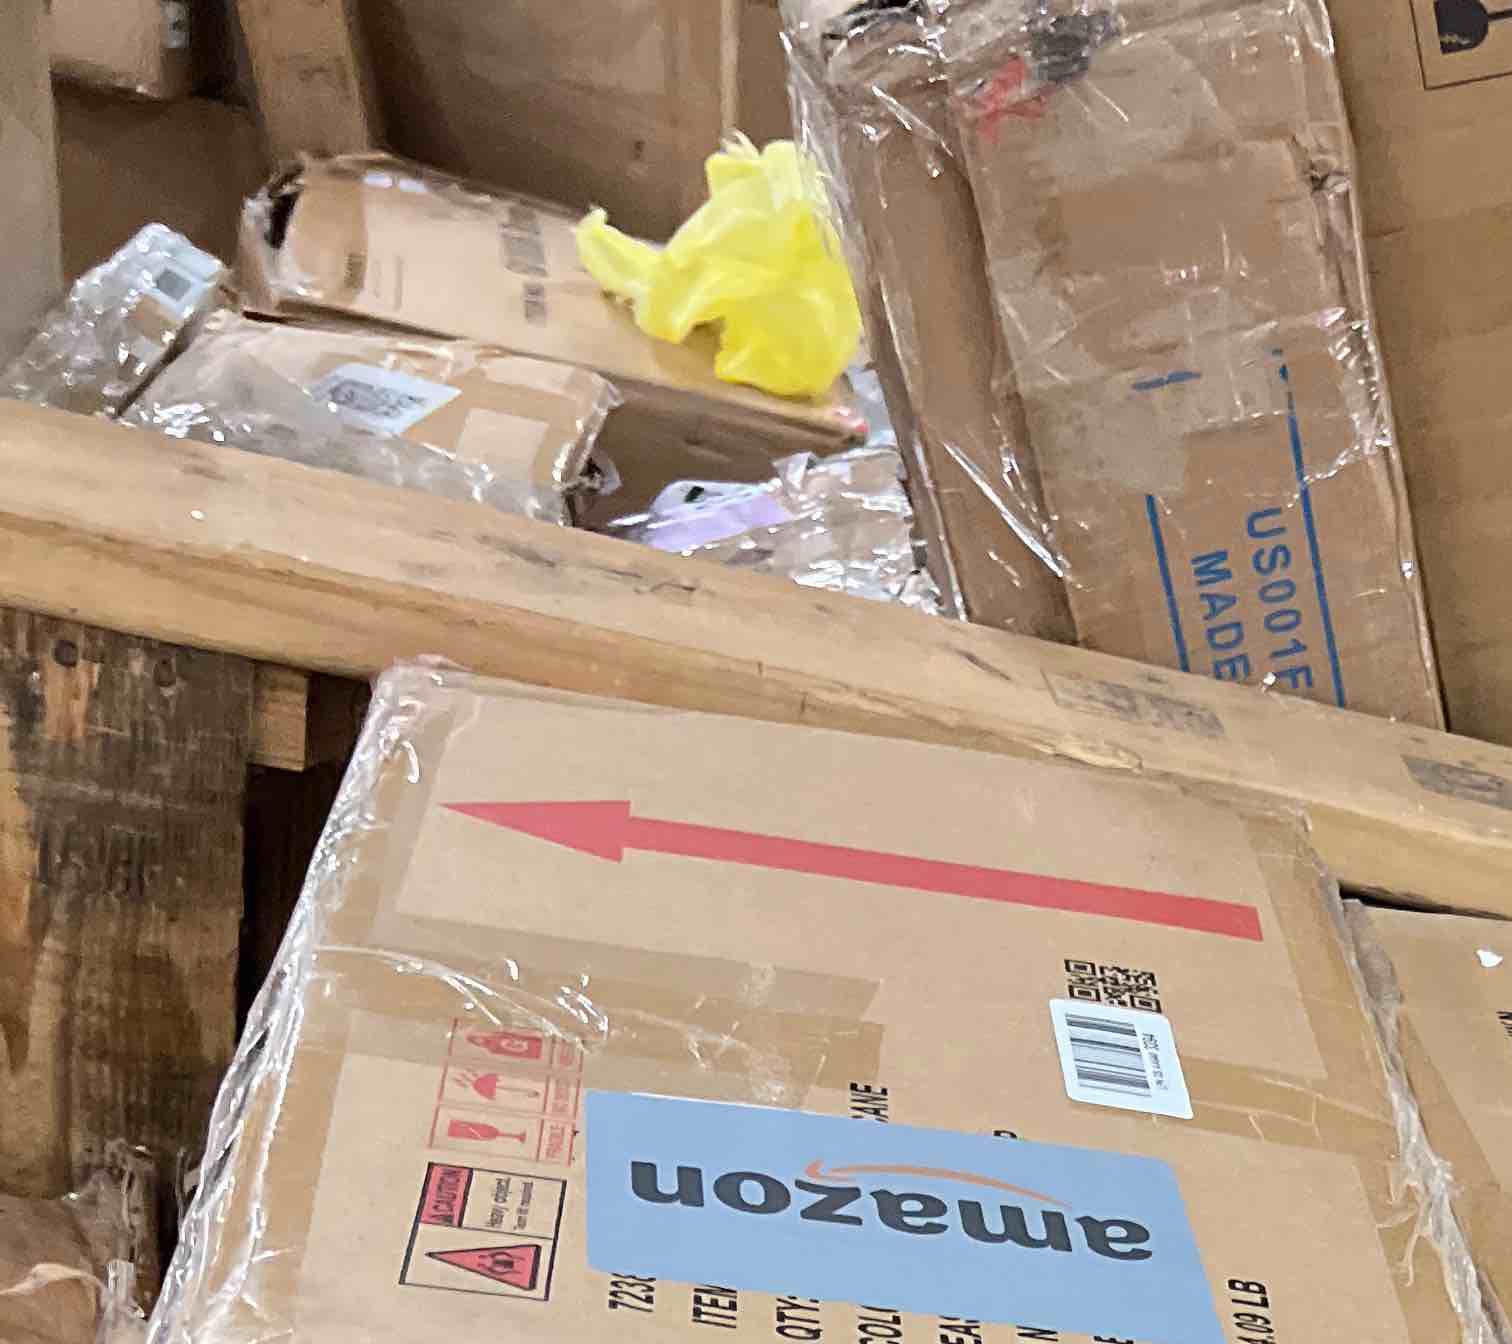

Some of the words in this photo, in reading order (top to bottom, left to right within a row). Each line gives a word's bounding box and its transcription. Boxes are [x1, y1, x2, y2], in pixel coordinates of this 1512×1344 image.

[1190, 549, 1251, 681] MADE
[1246, 506, 1314, 689] US001F
[630, 1160, 1154, 1262] amazon
[1226, 1278, 1270, 1311] LB
